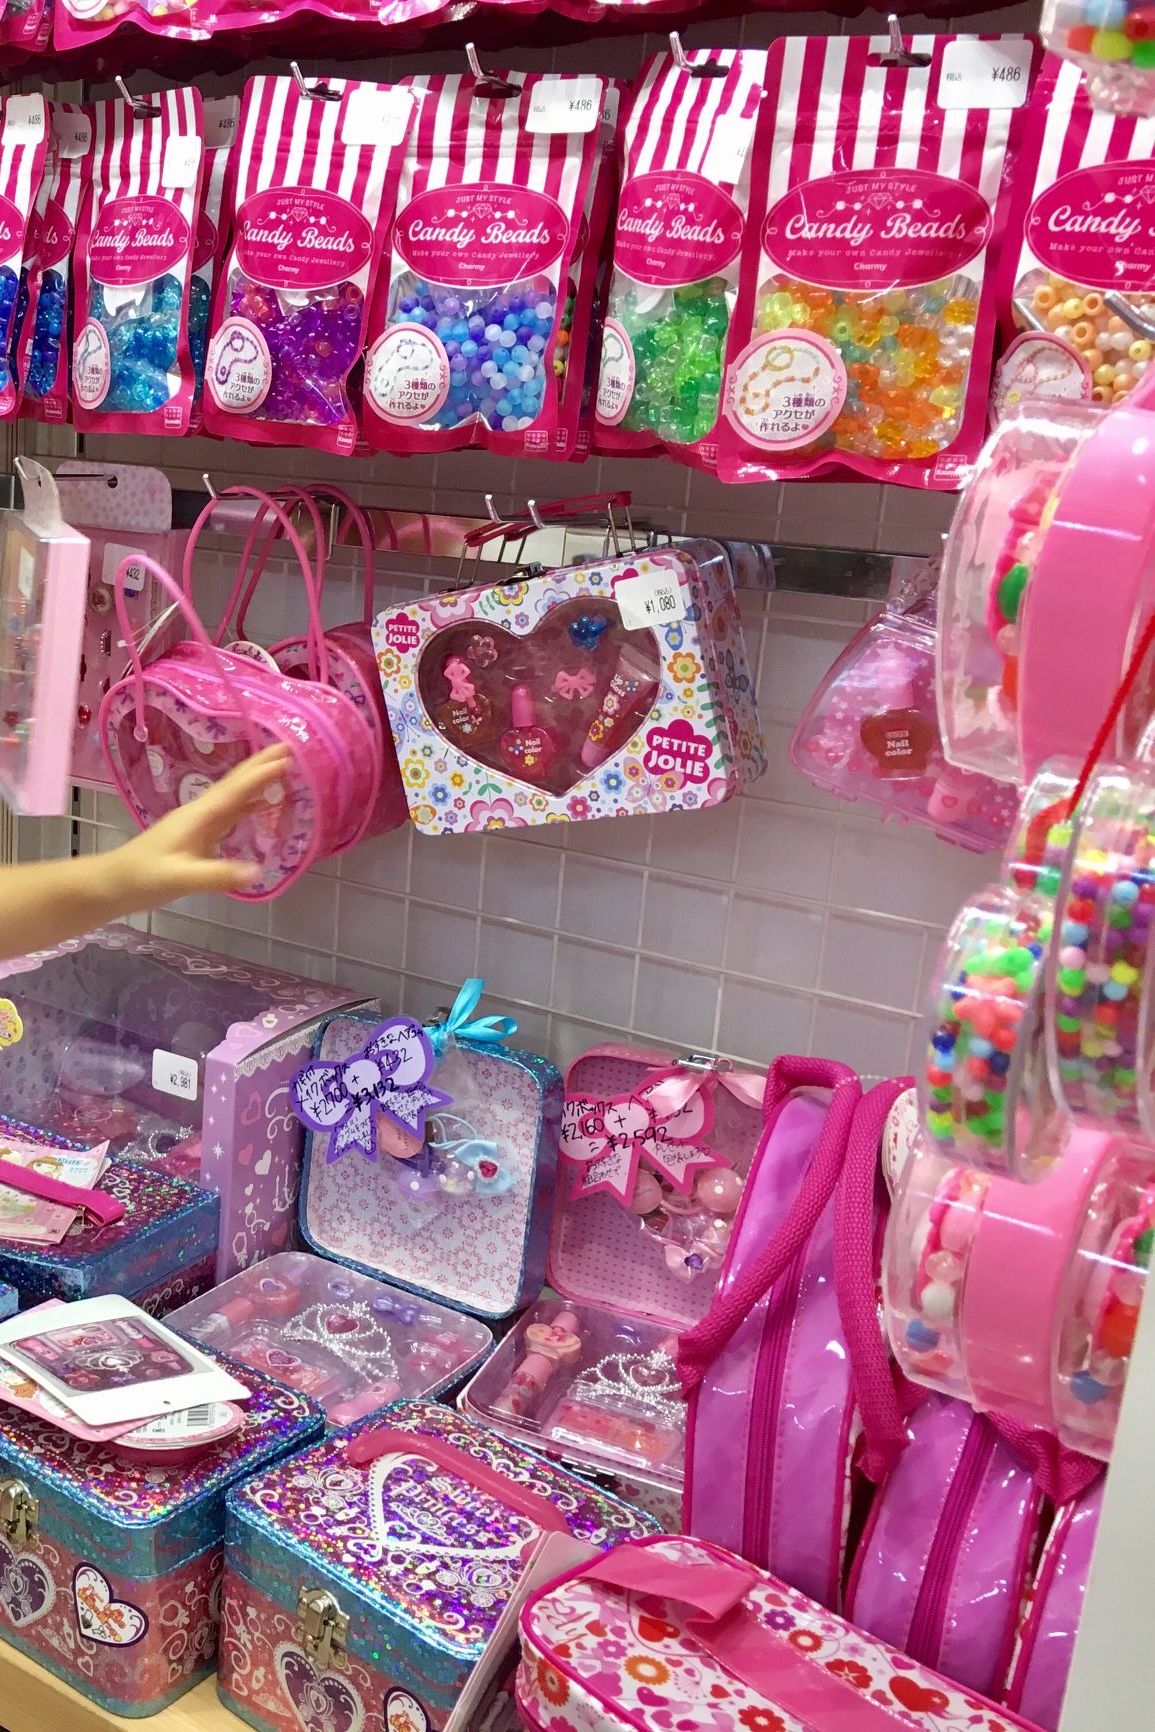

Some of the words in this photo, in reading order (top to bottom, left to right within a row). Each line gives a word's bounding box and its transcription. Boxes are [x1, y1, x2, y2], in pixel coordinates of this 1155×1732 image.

[991, 66, 1021, 82] ¥486
[568, 99, 593, 112] ¥486
[1117, 174, 1143, 186] JUST
[846, 183, 869, 193] JUST
[872, 182, 886, 191] MY
[887, 183, 918, 193] STYLE
[277, 198, 293, 207] JUST
[455, 194, 475, 204] JUST
[476, 194, 488, 202] MY
[488, 194, 513, 205] STYLE
[617, 208, 665, 243] Candy
[666, 214, 725, 244] Beads
[785, 213, 874, 247] Candy
[880, 213, 966, 240] Beads
[1048, 205, 1142, 243] Candy
[132, 227, 175, 248] Beads
[243, 220, 294, 251] Candy
[297, 226, 355, 253] Beads
[408, 220, 475, 249] Candy
[481, 221, 551, 244] Beads
[412, 249, 430, 257] Make
[472, 250, 496, 259] Candy
[788, 248, 814, 257] Make
[818, 248, 842, 258] your
[846, 249, 866, 257] own
[869, 248, 901, 258] Candy
[1049, 242, 1076, 251] Make
[1079, 245, 1104, 253] your
[1107, 247, 1130, 255] own
[1134, 247, 1155, 256] Can
[458, 262, 486, 272] Charmy
[854, 262, 888, 272] Charmy
[404, 378, 436, 391] 3種類の
[397, 390, 430, 400] アクセが
[389, 400, 420, 411] 作れるよ
[782, 395, 826, 408] 3種類の
[772, 409, 815, 420] アクセが
[759, 420, 801, 433] 作れるよ
[645, 596, 677, 615] ¥1,080
[388, 624, 418, 633] PETITE
[388, 633, 418, 645] JOLIE
[610, 680, 626, 697] Gloss
[452, 708, 468, 717] Nail
[452, 715, 470, 725] color
[524, 737, 541, 747] Nail
[652, 735, 707, 757] PETITE
[886, 739, 910, 749] Nail
[524, 746, 543, 755] color
[885, 748, 913, 757] color
[648, 750, 706, 777] JOLIE
[376, 1047, 413, 1077] ¥432
